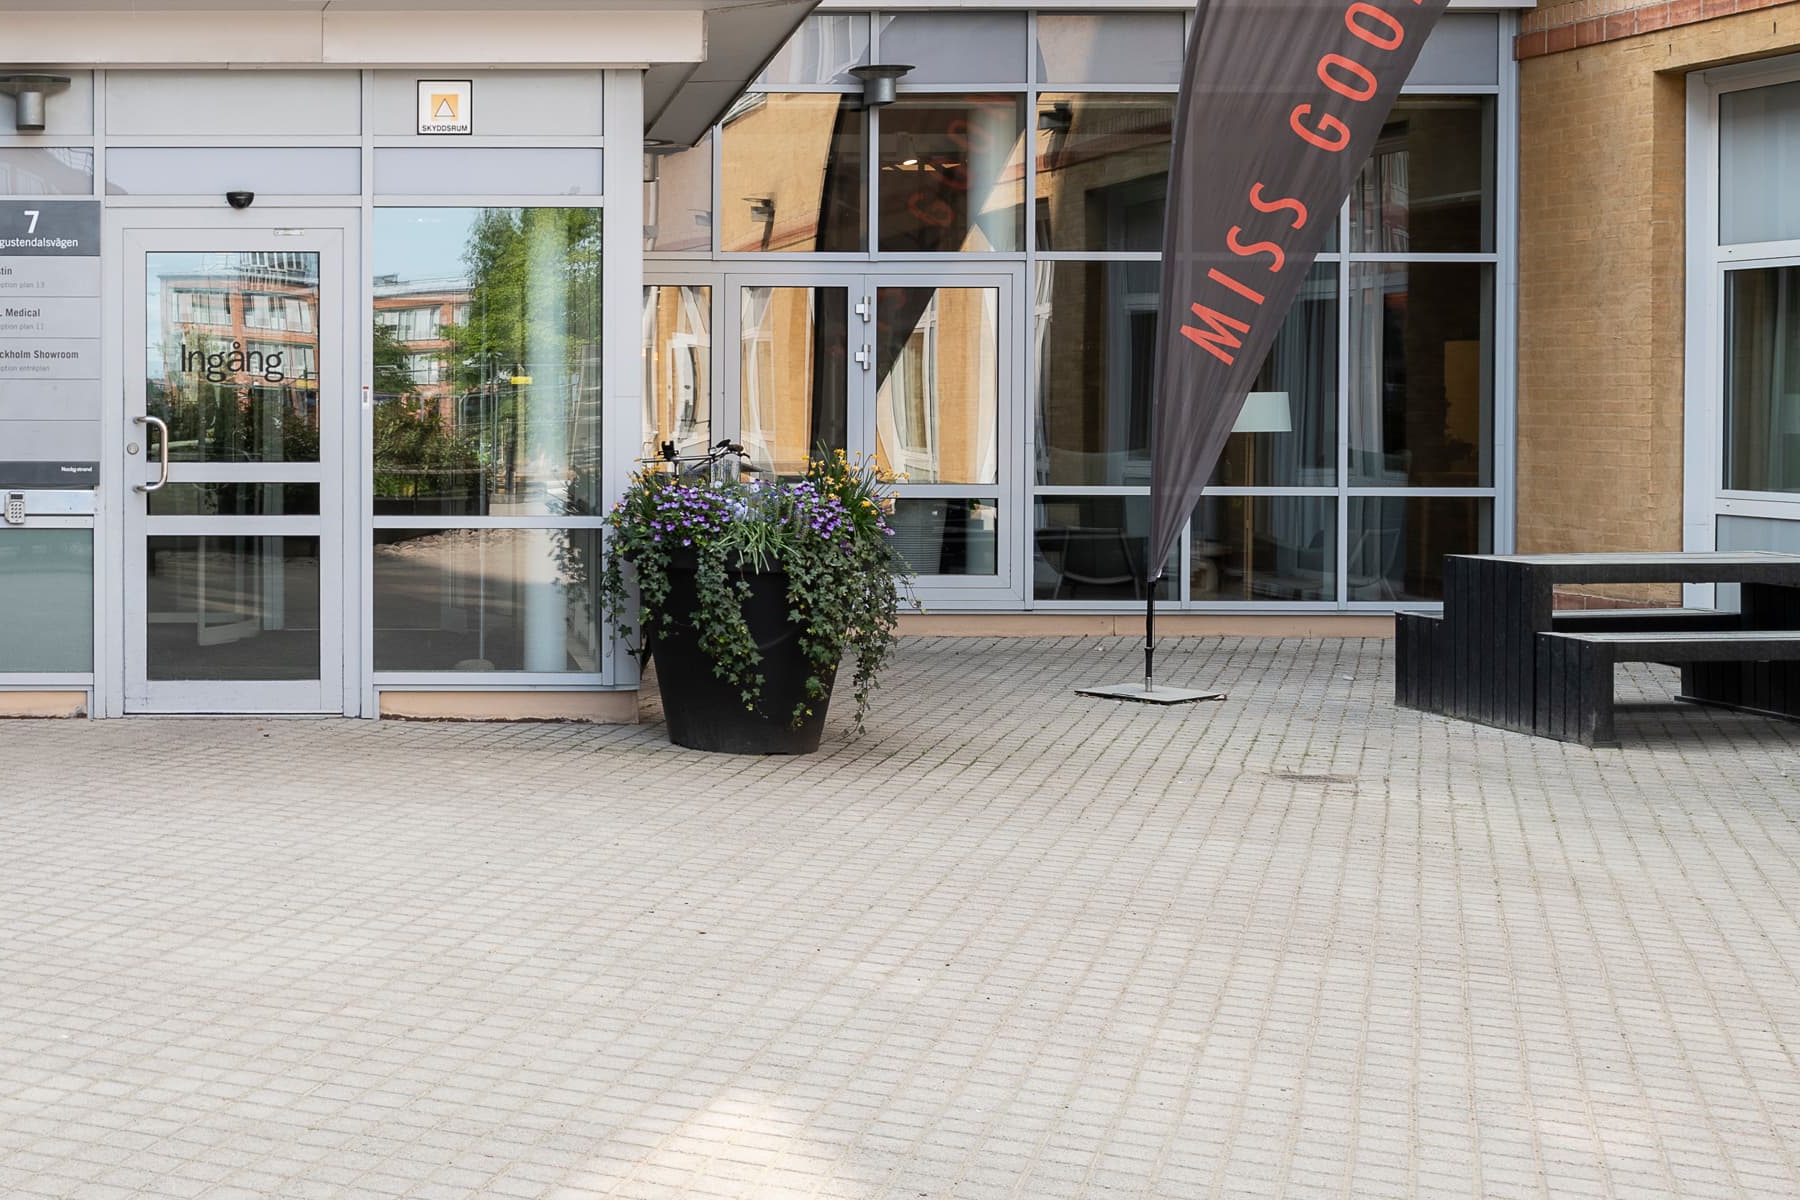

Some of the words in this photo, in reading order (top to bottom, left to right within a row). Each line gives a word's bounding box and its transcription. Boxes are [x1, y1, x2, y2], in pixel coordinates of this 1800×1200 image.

[422, 124, 468, 132] SKYDDSRUM
[23, 210, 40, 234] 7
[1180, 182, 1308, 366] MISS
[5, 308, 41, 318] Medical
[33, 350, 80, 360] Showroom
[181, 341, 285, 383] Ingång
